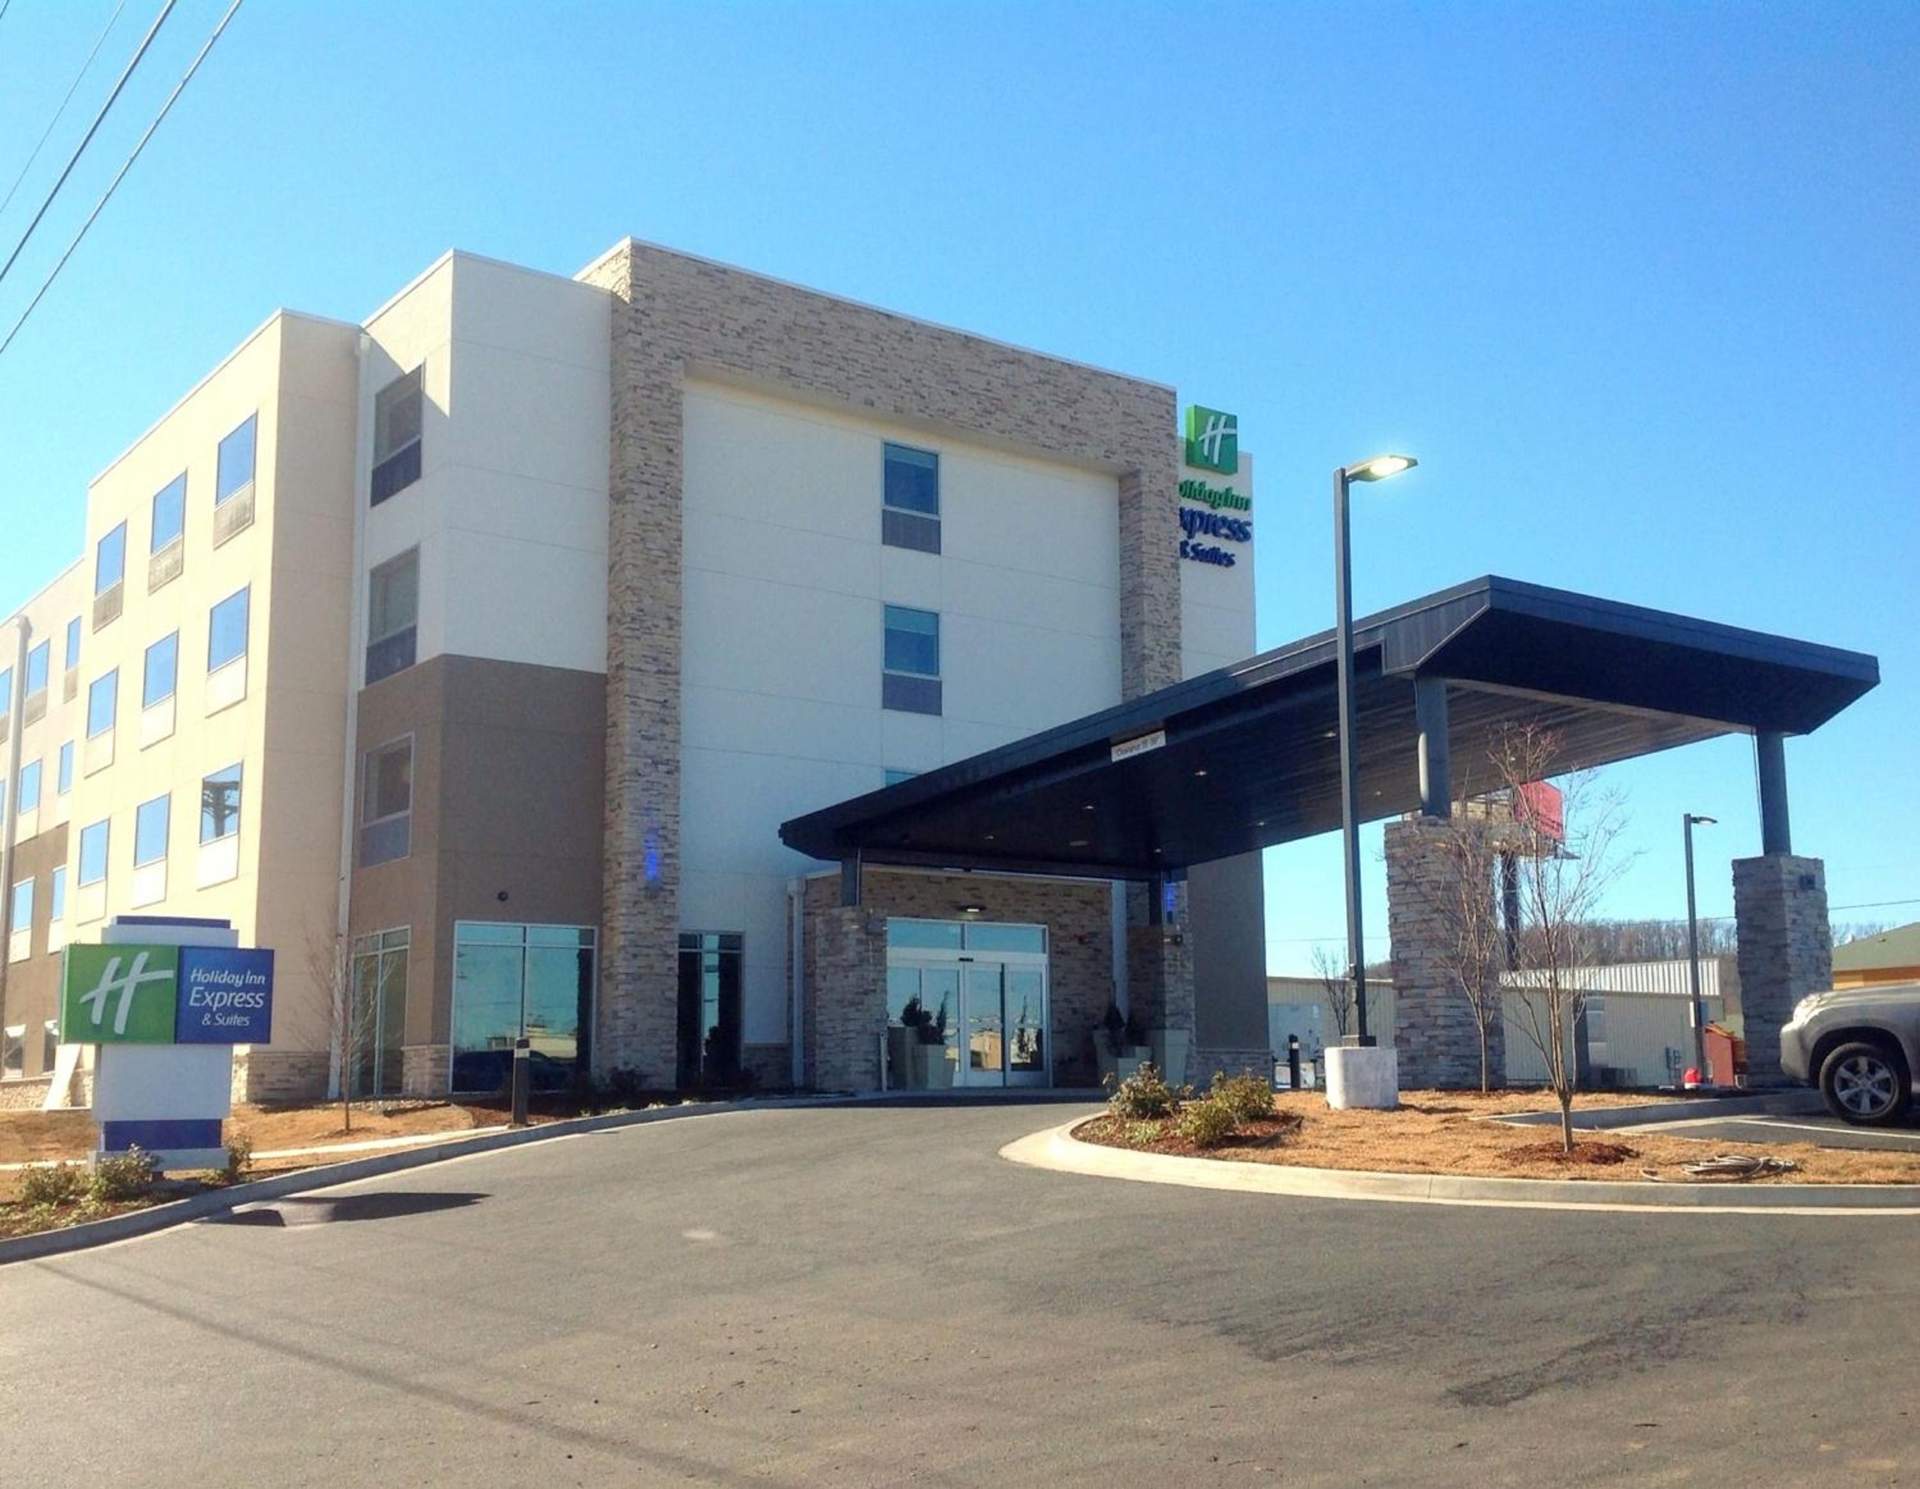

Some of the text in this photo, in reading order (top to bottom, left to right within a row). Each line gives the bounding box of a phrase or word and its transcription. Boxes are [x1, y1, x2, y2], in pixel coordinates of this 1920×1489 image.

[1179, 479, 1223, 510] oliday
[1179, 507, 1252, 542] xpress
[1190, 542, 1236, 568] Suites
[189, 967, 266, 988] Holiday Inn
[189, 986, 266, 1012] Express
[201, 1012, 251, 1026] & Suites
